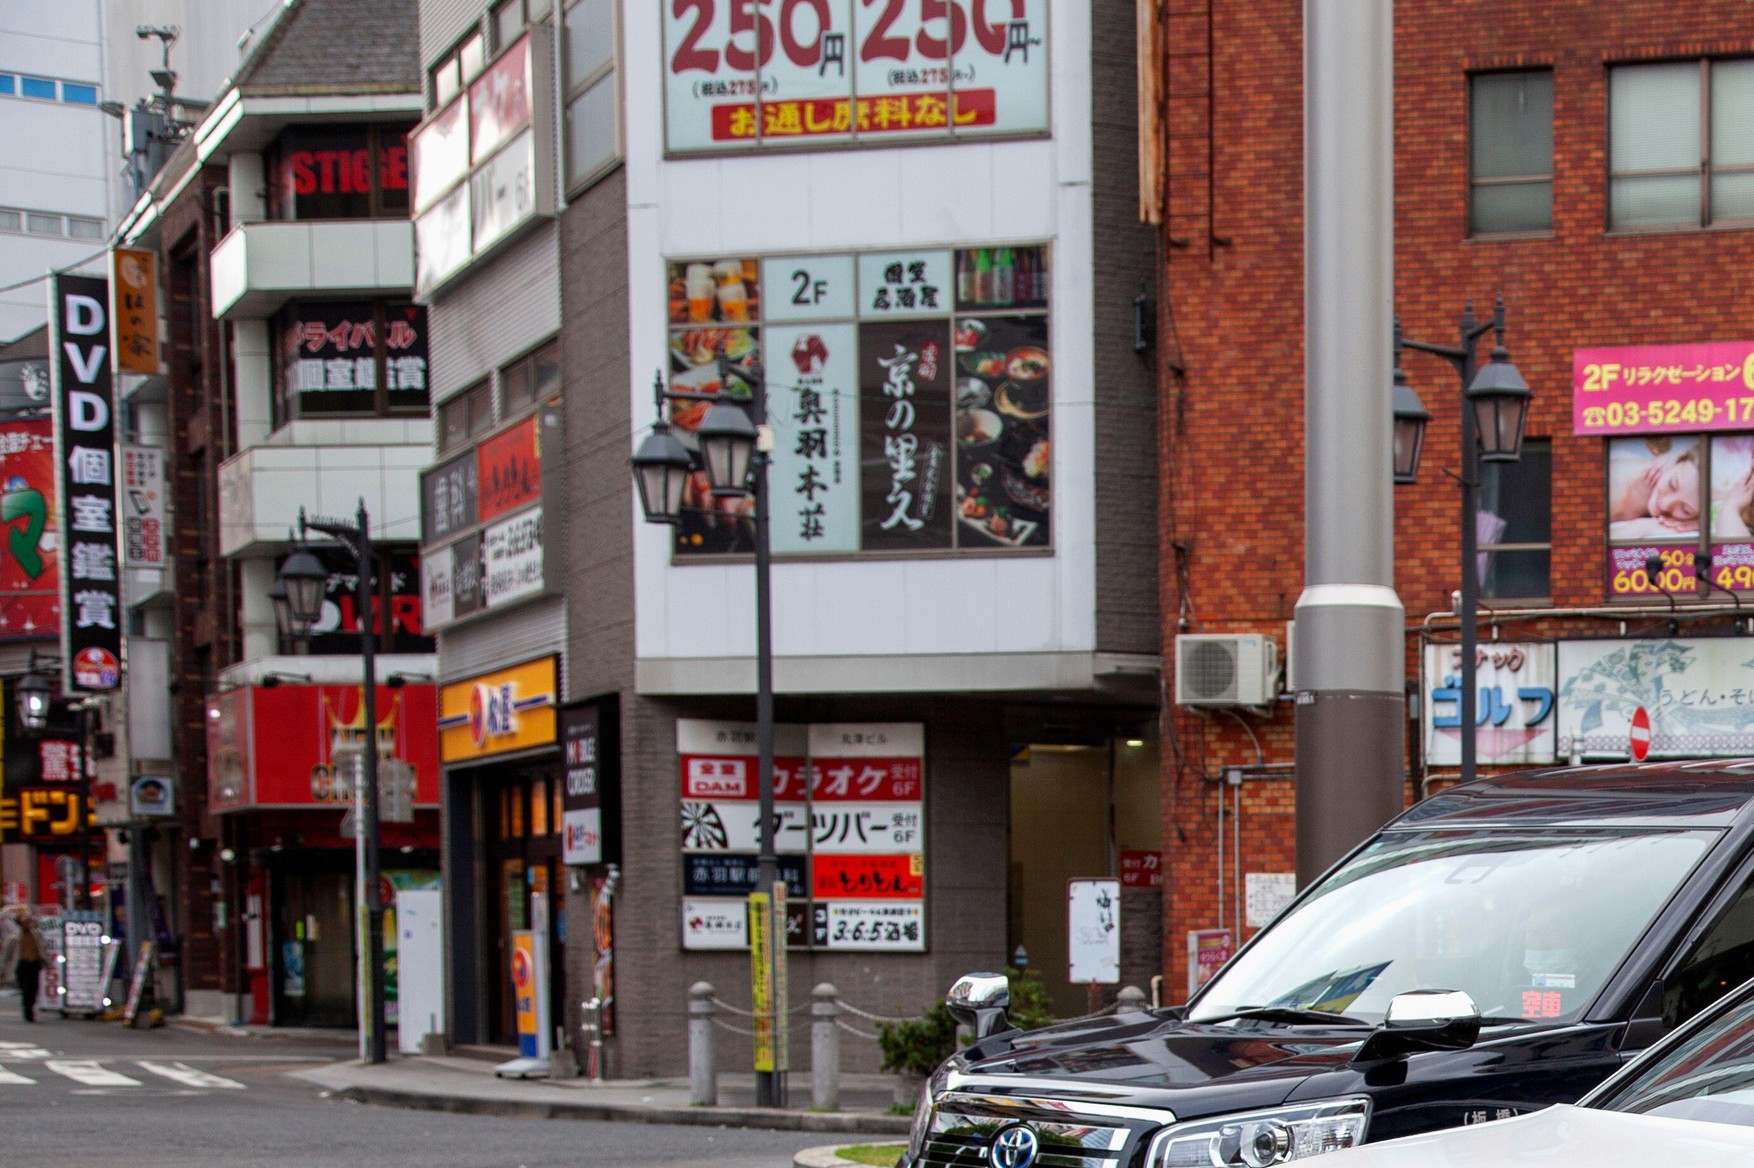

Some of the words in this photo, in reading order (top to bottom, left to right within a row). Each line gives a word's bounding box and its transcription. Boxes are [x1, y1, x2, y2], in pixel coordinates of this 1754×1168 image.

[791, 269, 828, 305] 2F
[1582, 363, 1620, 391] 2F
[1623, 364, 1742, 387] リラクゼーション
[1432, 675, 1554, 729] ゴルフ
[892, 781, 915, 797] 6F
[892, 828, 915, 844] 6F
[1520, 990, 1562, 1018] 空車
